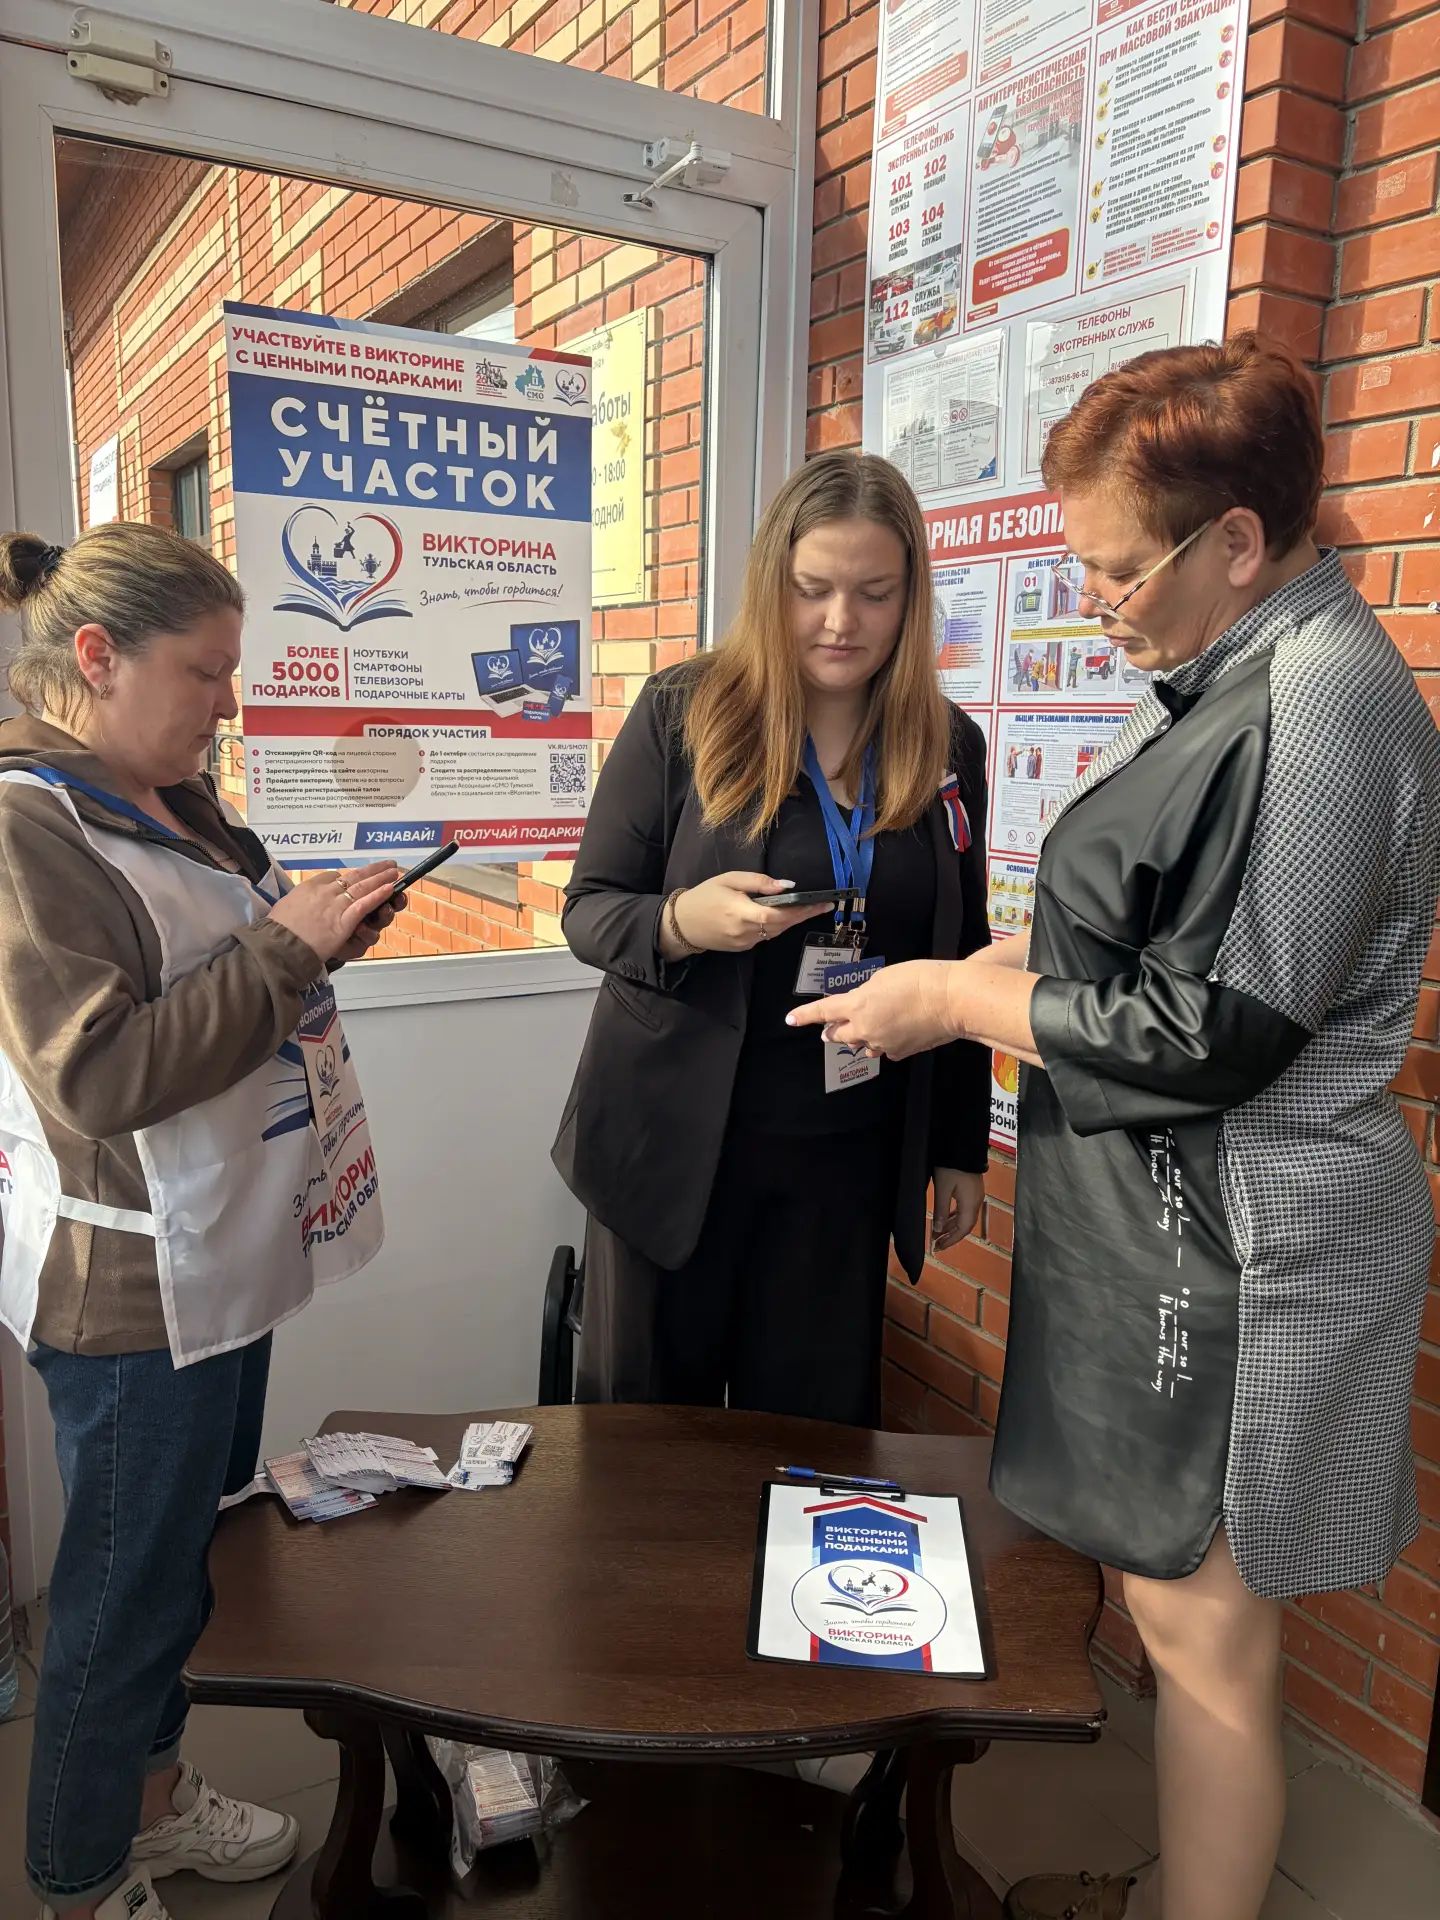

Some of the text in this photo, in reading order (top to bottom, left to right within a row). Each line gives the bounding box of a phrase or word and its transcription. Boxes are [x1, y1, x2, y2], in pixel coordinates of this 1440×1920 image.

[1126, 21, 1145, 38] КАК
[1147, 5, 1177, 28] ВЕСТИ
[1099, 46, 1117, 67] ПРИ
[1120, 20, 1172, 57] МАССОВОЙ
[978, 46, 1087, 113] АНТИТЕРРОРИСТИЧЕСКАЯ
[1016, 63, 1085, 107] БЕЗОПАСНОСТЬ
[904, 122, 939, 151] ТЕЛЕФОНЫ
[888, 128, 955, 172] ЭКСТРЕННЫХ СЛУЖБ
[891, 171, 912, 195] 101
[924, 154, 947, 179] 102
[890, 201, 910, 216] СЛУЖБА
[888, 202, 944, 241] 103 104
[921, 232, 942, 247] СЛУЖБА
[885, 285, 941, 324] 112 СЛУЖБА
[911, 297, 943, 317] СПАСЕНИЯ
[1077, 306, 1131, 331] ТЕЛЕФОНЫ
[1053, 318, 1155, 354] ЭКСТРЕННЫХ СЛУЖБ
[232, 325, 465, 373] УЧАСТВУЙТЕ В ВИКТОРИНЕ
[235, 349, 463, 393] С ЦЕННЫМИ ПОДАРКАМИ!
[526, 391, 545, 400] СМО
[271, 394, 558, 465] СЧЁТНЫЙ
[278, 448, 556, 511] УЧАСТОК
[604, 458, 626, 484] 18:00
[422, 532, 557, 561] ВИКТОРИНА
[423, 556, 557, 576] ТУЛЬСКАЯ ОБЛАСТЬ
[1024, 575, 1037, 588] 01
[419, 581, 564, 607] Знать, чтобы гордиться!
[286, 645, 339, 659] БОЛЕЕ
[353, 648, 409, 660] НОУТБУКИ
[272, 661, 340, 683] 5000
[353, 662, 423, 674] СМАРТФОНЫ
[252, 684, 341, 699] ПОДАРКОВ
[353, 675, 424, 687] ТЕЛЕВИЗОРЫ
[354, 689, 466, 702] ПОДАРОЧНЫЕ КАРТЫ
[368, 726, 488, 739] ПОРЯДОК УЧАСТИЯ
[261, 823, 585, 846] УЧАСТВУЙ! УЗНАВАЙ! ПОЛУЧАЙ ПОДАРКИ!
[1006, 864, 1035, 874] ОСНОВНЫЕ
[300, 996, 334, 1029] ВОЛОНТЁР
[1007, 1103, 1017, 1116] П
[356, 1174, 378, 1206] ОБЛ
[1158, 1307, 1173, 1341] knows
[1157, 1345, 1174, 1366] the
[1150, 1369, 1164, 1394] way
[824, 1533, 908, 1547] С ЦЕННЫМИ
[825, 1525, 907, 1539] ВИКТОРИНА
[824, 1542, 909, 1556] ПОДАРКАМИ
[828, 1628, 913, 1642] ВИКТОРИНА
[828, 1635, 914, 1648] ТУЛЬСКАЯ ОБЛАСТЬ
